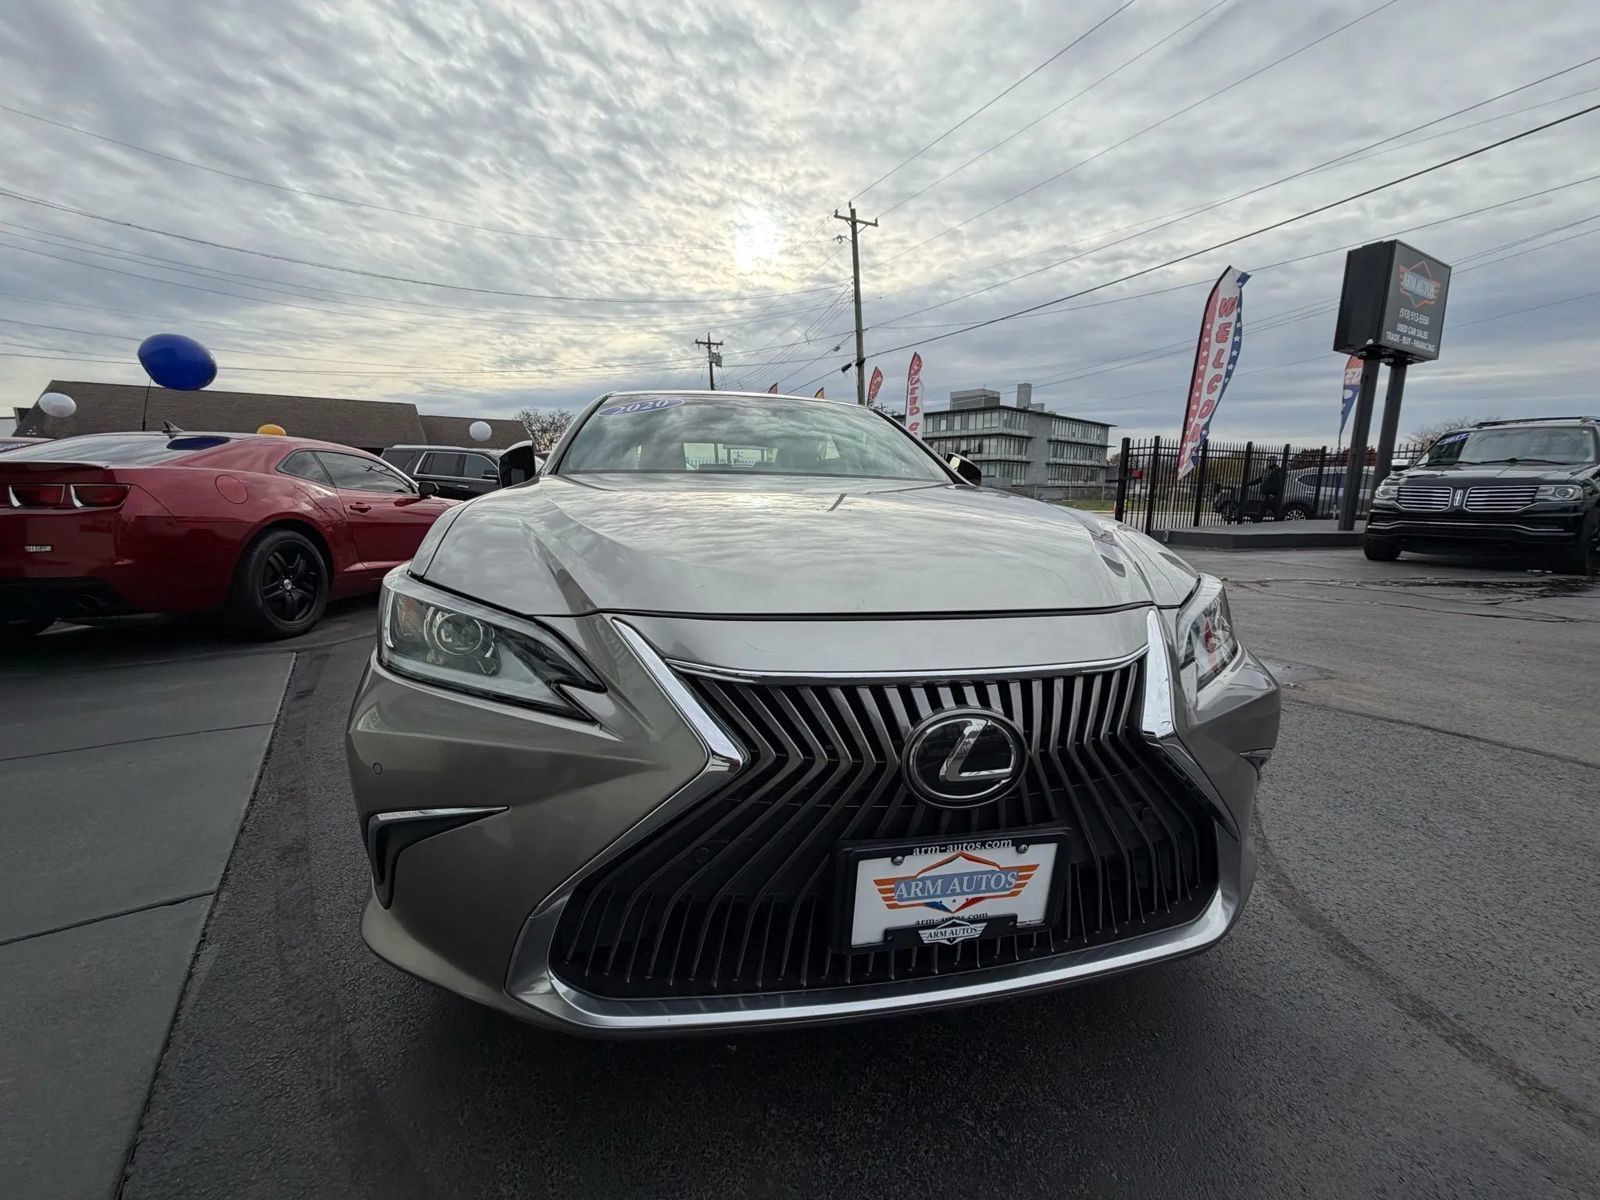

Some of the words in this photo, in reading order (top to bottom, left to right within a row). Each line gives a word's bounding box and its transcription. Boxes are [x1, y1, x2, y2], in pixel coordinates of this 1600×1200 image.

[612, 400, 669, 415] 2020
[912, 839, 1013, 856] arm-autos.com
[894, 879, 943, 899] ARM
[945, 871, 1018, 894] AUTOS
[927, 930, 949, 940] ARM
[950, 926, 979, 938] AUTOS
